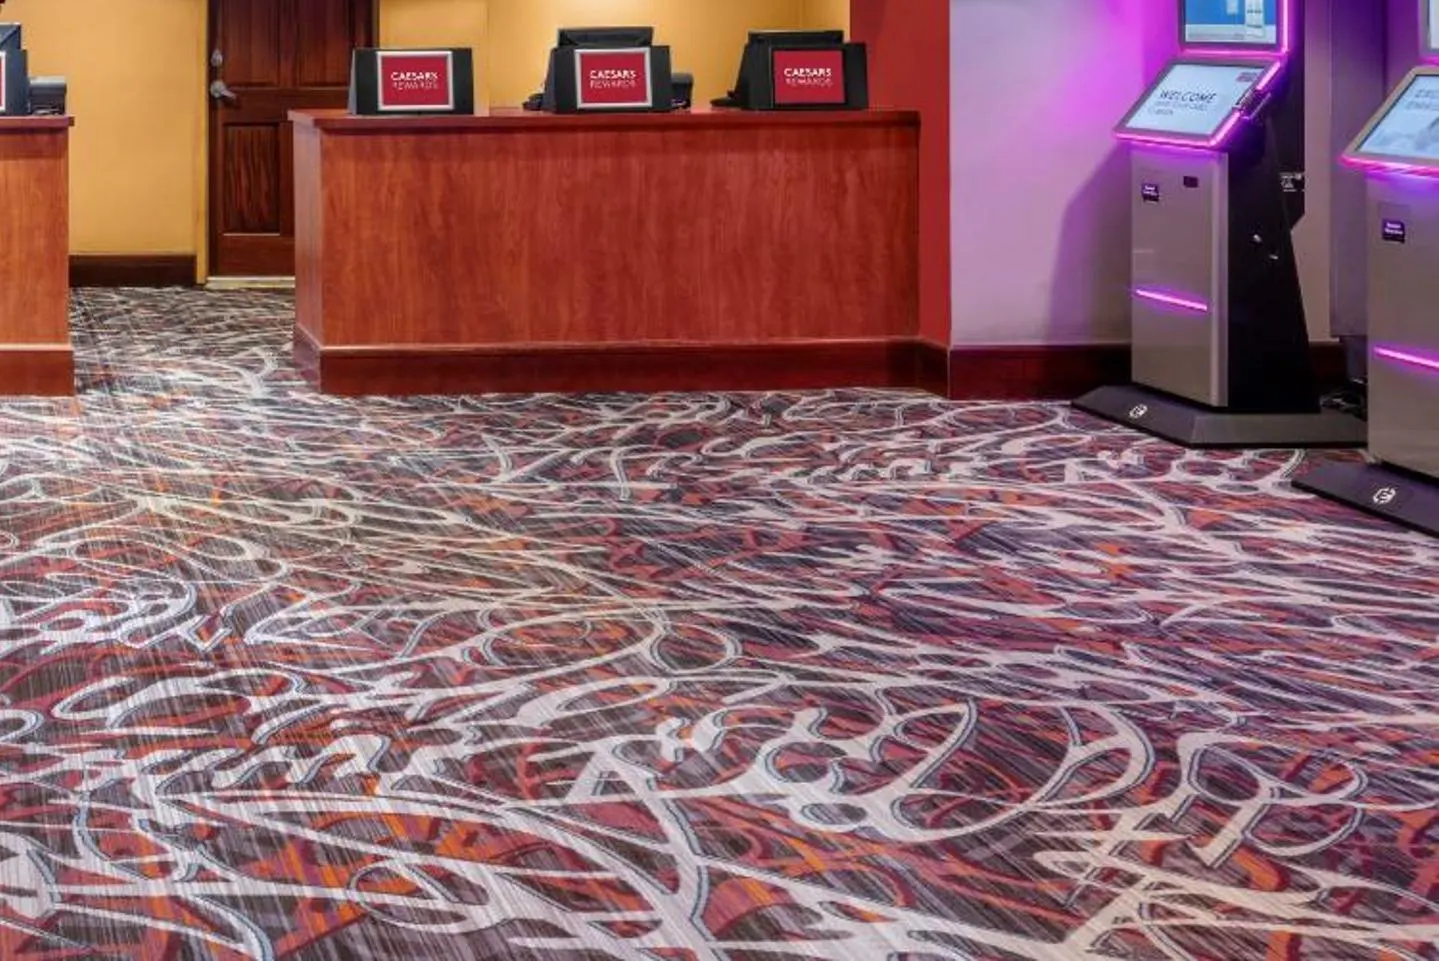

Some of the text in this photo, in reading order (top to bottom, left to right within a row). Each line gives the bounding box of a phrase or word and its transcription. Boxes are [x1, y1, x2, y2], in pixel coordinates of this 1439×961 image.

[390, 71, 438, 81] CAESARS
[590, 70, 637, 79] CAESARS
[783, 67, 832, 77] CAESARS
